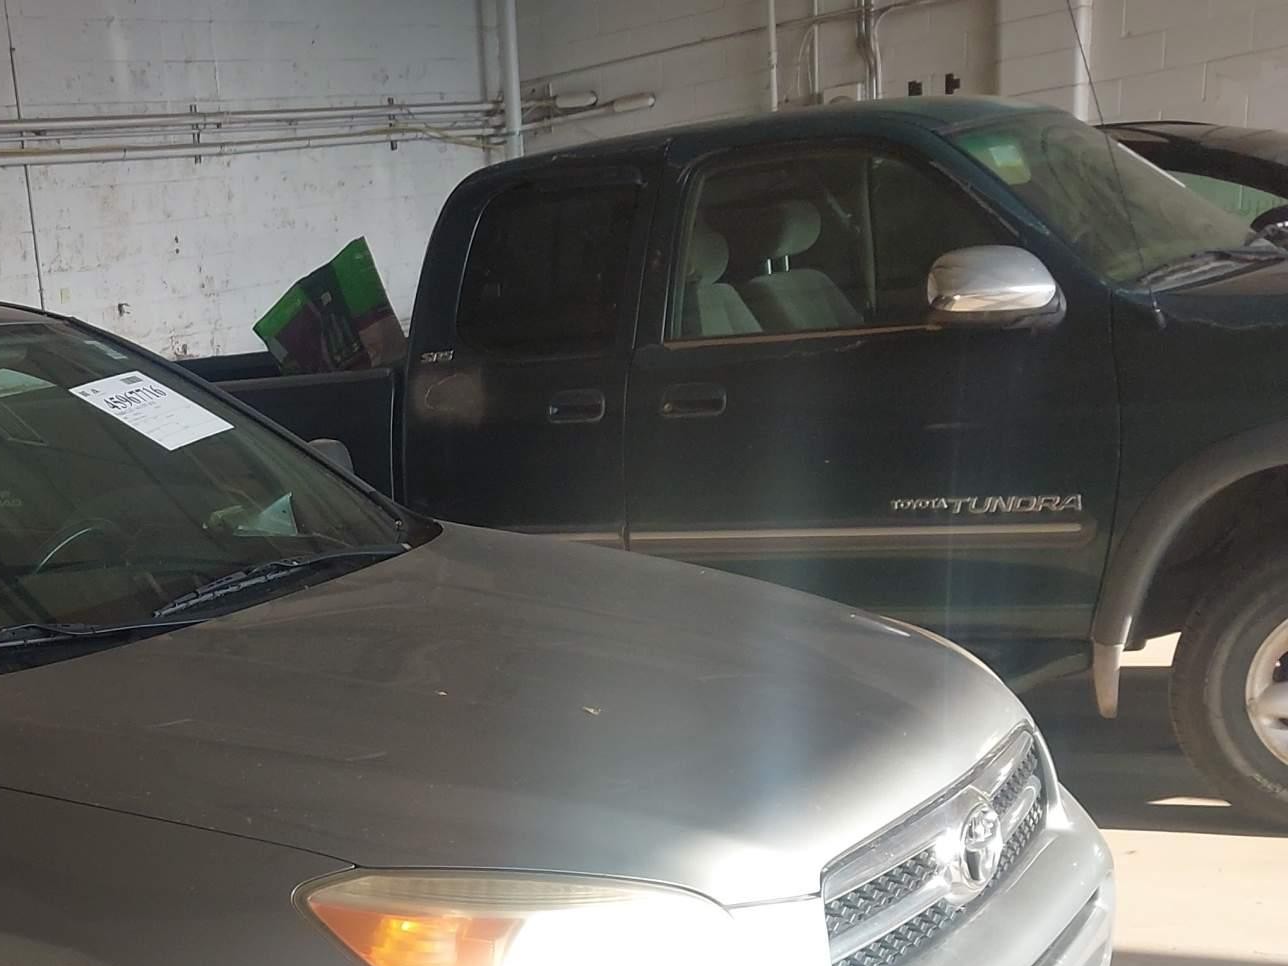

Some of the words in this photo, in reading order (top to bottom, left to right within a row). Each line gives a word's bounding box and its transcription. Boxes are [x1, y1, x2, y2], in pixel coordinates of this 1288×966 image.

[103, 384, 168, 411] 45967716
[892, 497, 949, 511] TOYOTA
[950, 494, 1083, 514] TUNDRA
